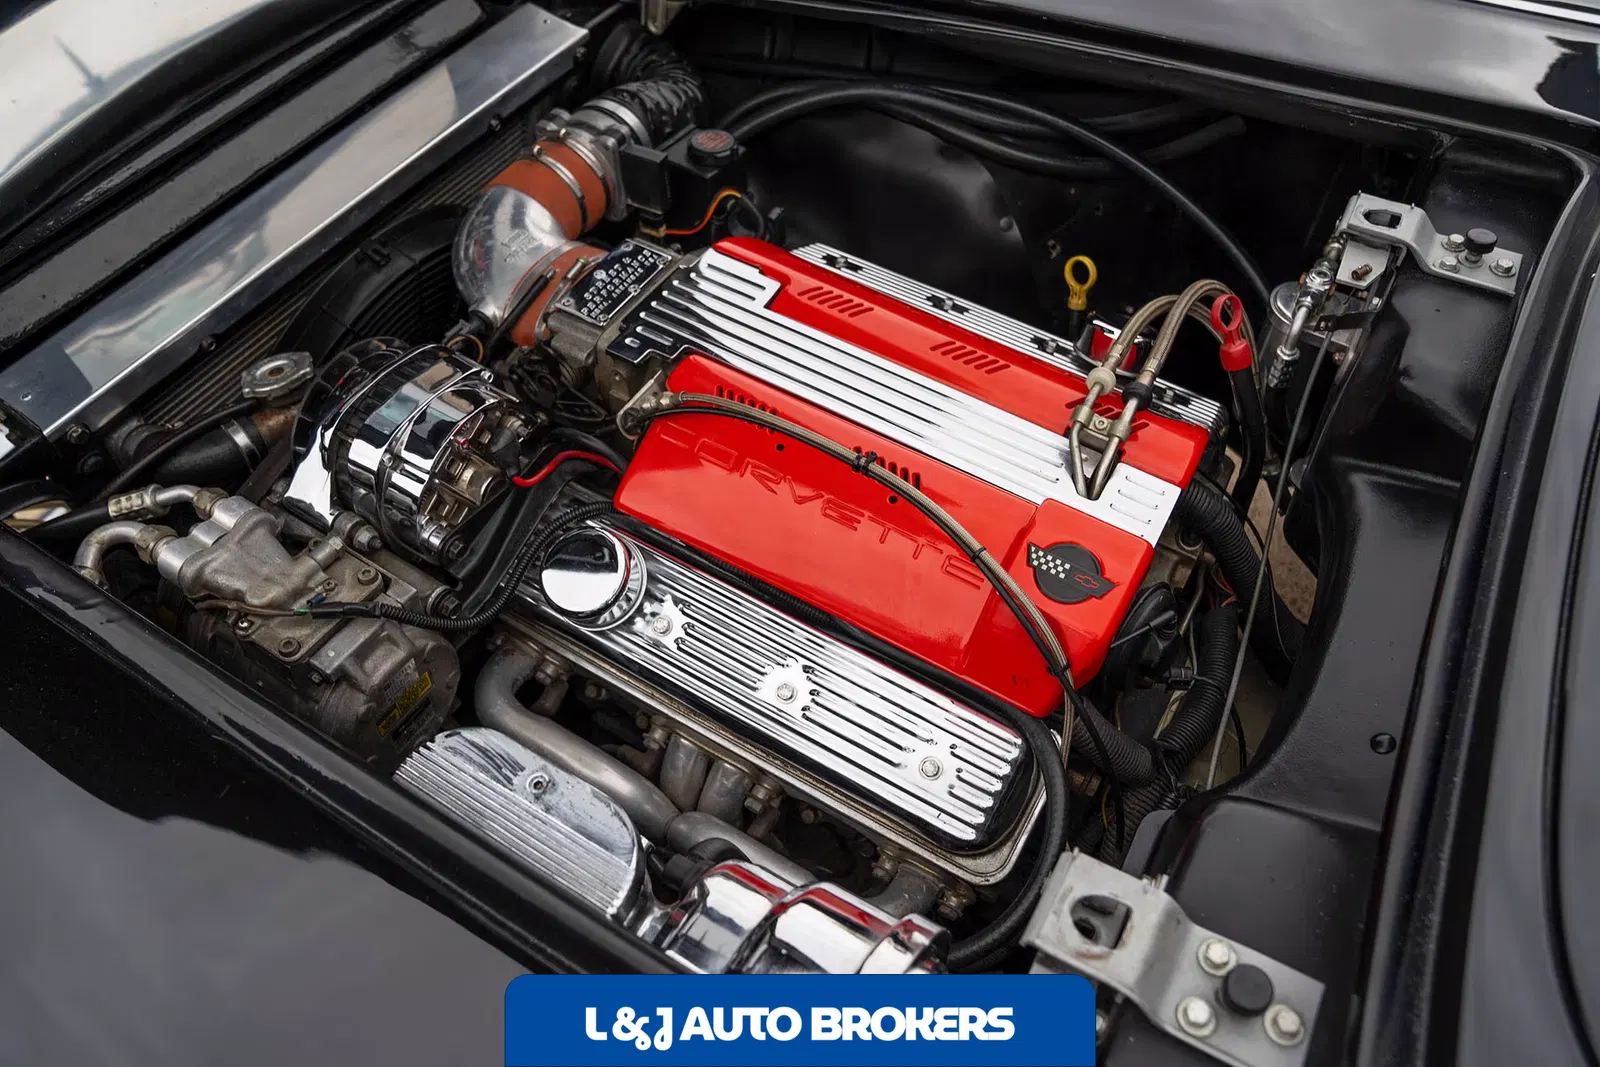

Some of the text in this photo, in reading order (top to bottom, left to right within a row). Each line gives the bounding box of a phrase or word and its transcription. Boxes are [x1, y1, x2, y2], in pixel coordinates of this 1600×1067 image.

[580, 249, 652, 316] PERFORMANCE
[583, 263, 622, 300] STREET
[656, 420, 985, 590] CORVETTE
